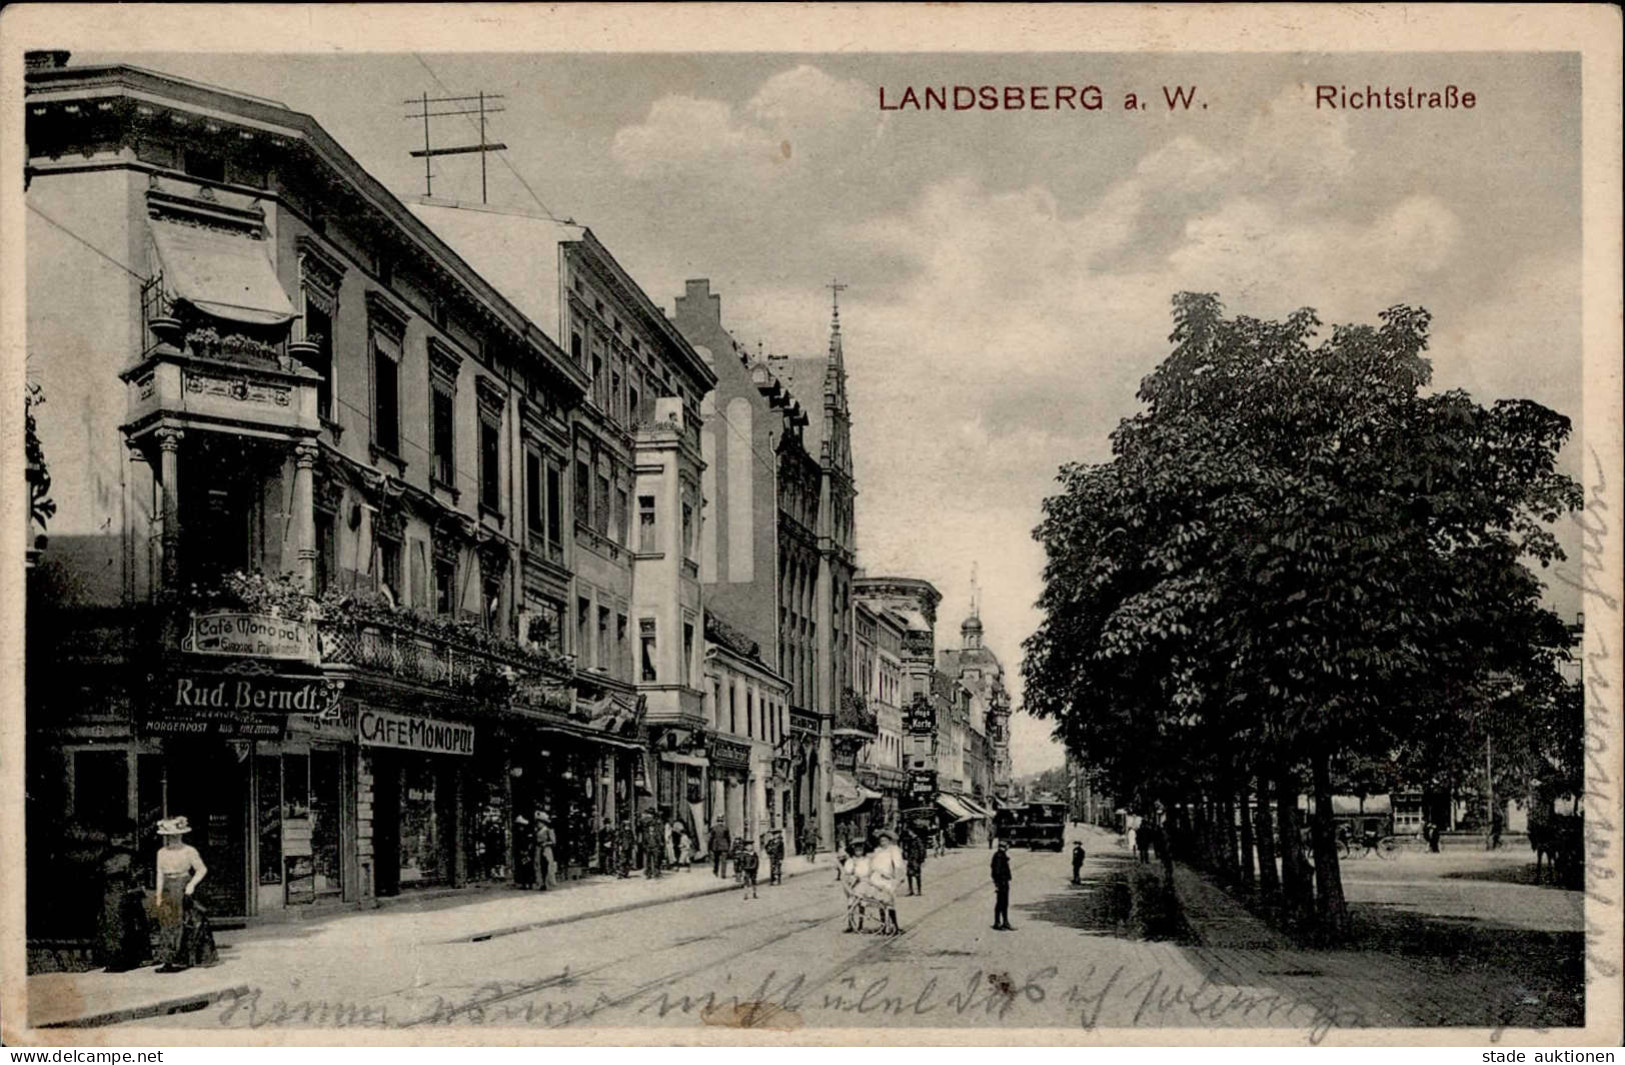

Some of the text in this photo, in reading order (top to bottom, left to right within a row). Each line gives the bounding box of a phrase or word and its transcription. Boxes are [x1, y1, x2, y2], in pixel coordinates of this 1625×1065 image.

[199, 616, 302, 641] Café Monopol
[175, 677, 230, 708] Rud.
[145, 720, 209, 734] MORGENPOST
[359, 711, 473, 753] CAFE MONOPOL
